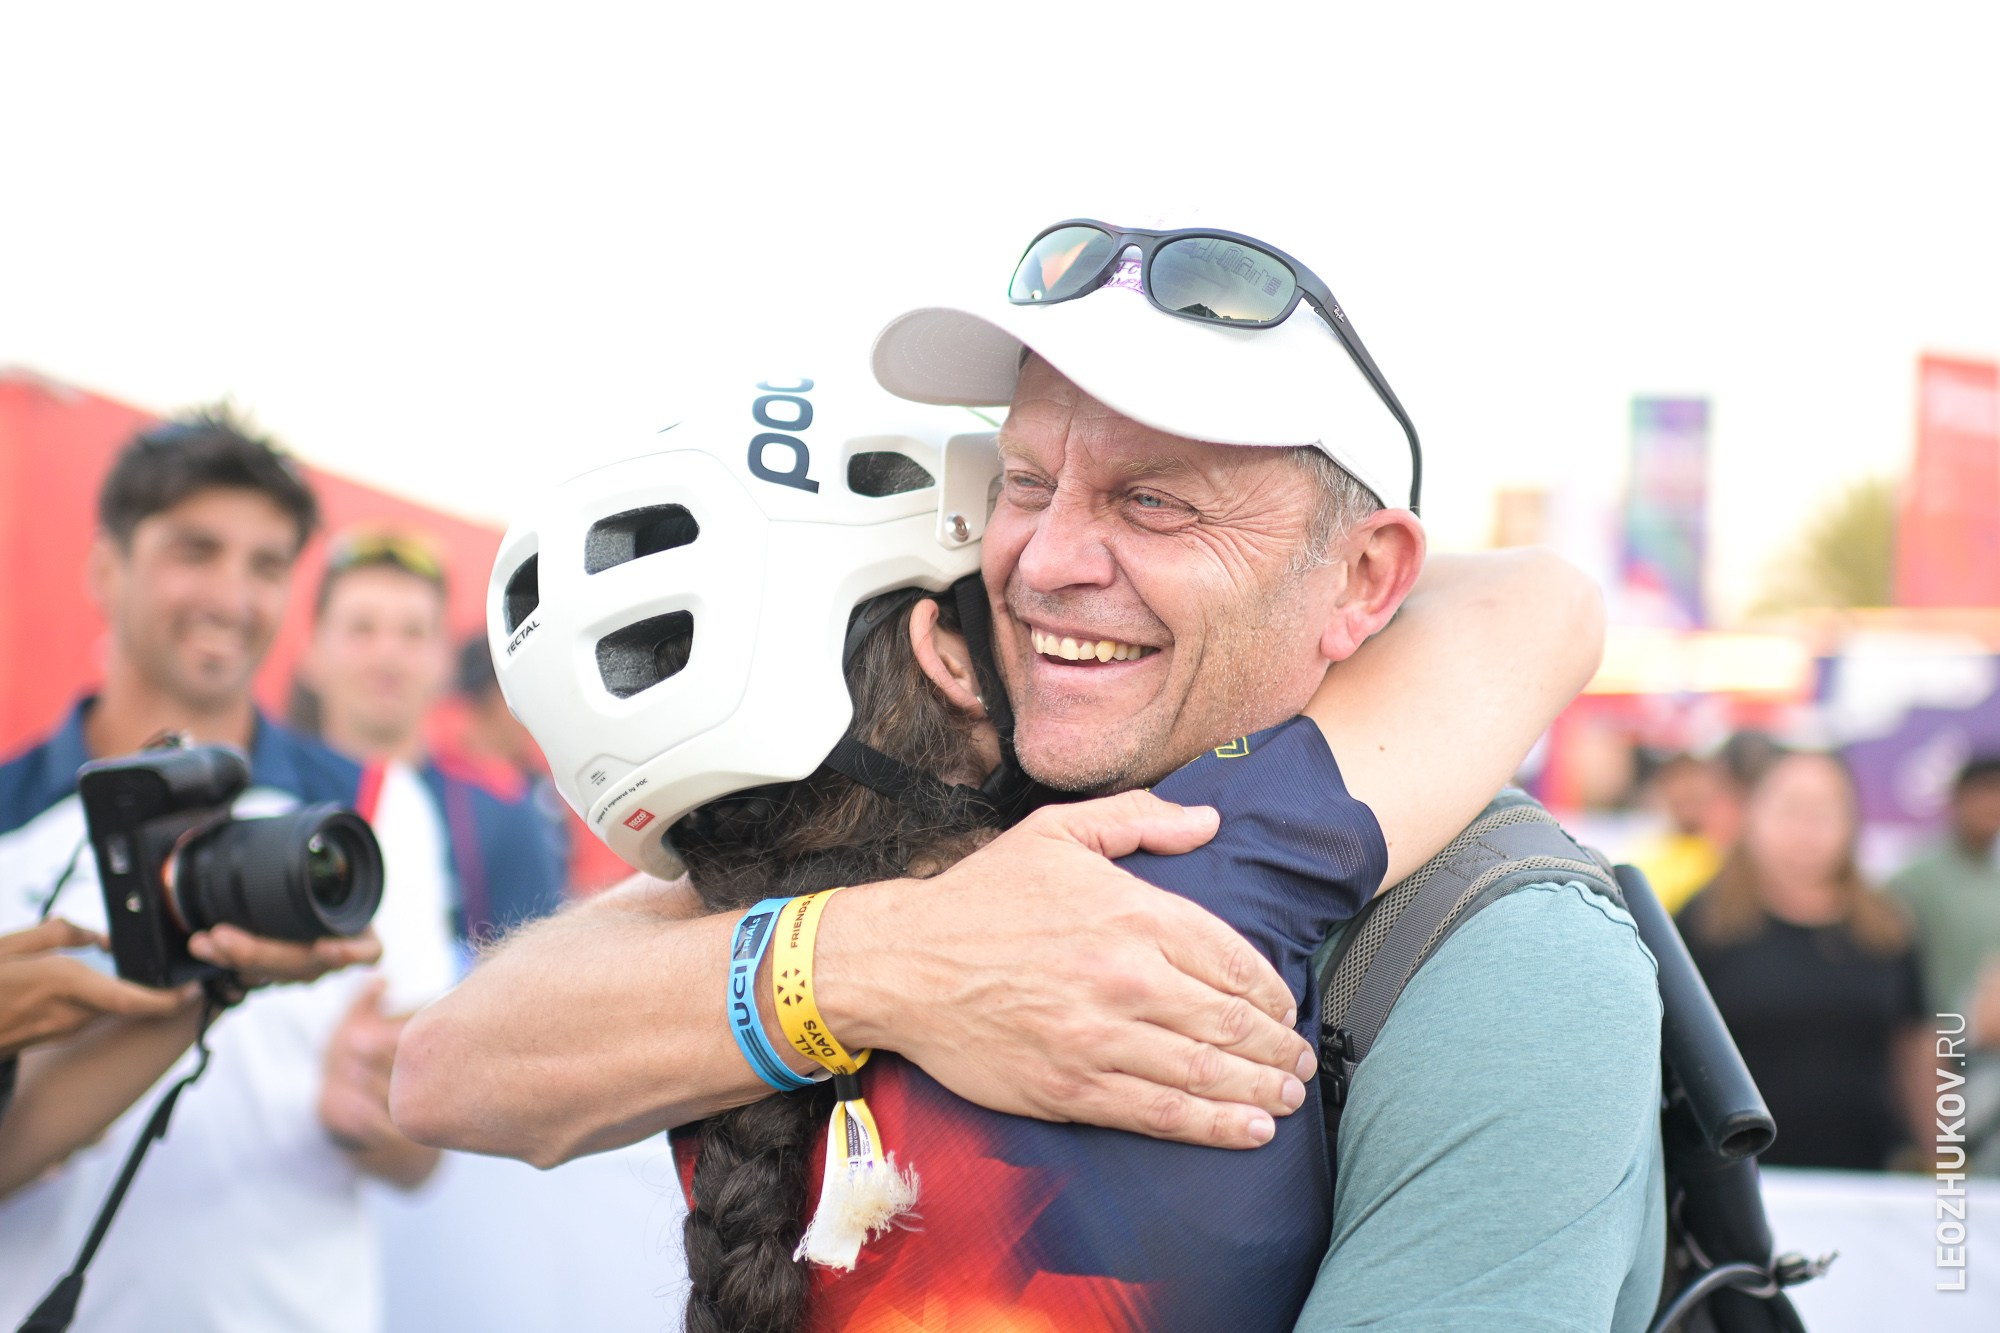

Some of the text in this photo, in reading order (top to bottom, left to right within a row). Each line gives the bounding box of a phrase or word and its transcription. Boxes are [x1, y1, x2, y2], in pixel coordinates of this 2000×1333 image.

[507, 621, 540, 656] TECTAL
[635, 778, 649, 788] POC
[741, 917, 762, 954] TRIALS
[791, 900, 811, 949] FRIENDS
[733, 965, 751, 1027] UCI
[795, 1034, 816, 1057] ALL
[803, 1020, 836, 1058] DAYS
